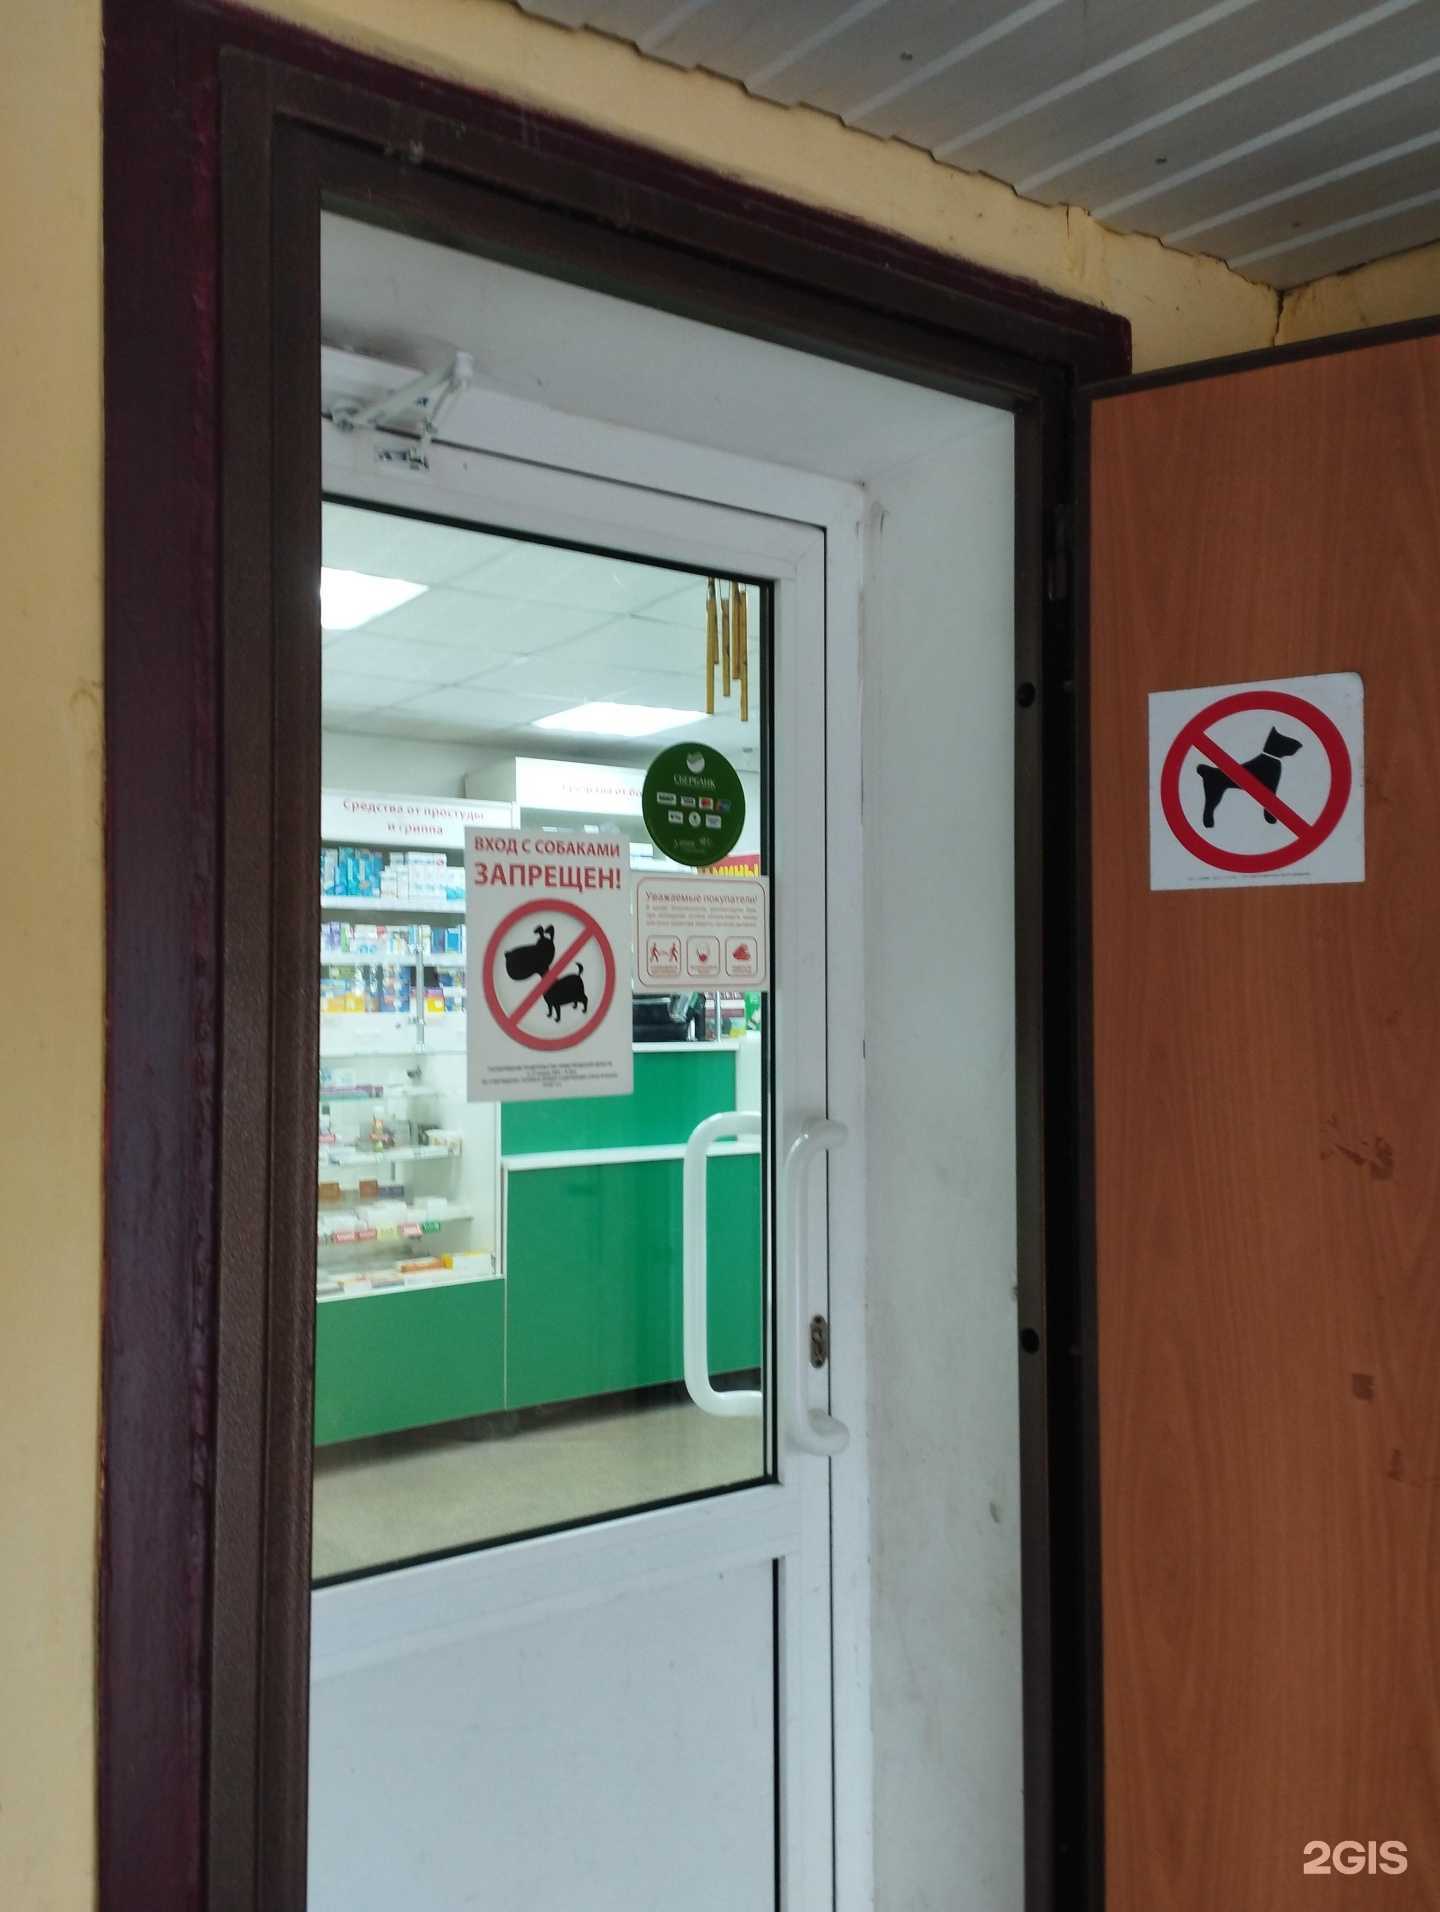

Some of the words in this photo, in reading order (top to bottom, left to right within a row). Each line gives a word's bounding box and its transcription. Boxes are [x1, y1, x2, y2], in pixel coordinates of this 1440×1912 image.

[343, 798, 403, 814] Средства
[407, 806, 421, 815] от
[424, 807, 484, 821] простуды
[474, 836, 518, 855] ВХОД
[521, 838, 531, 854] С
[535, 838, 620, 857] СОБАКАМИ
[474, 862, 621, 892] ЗАПРЕЩЕН!
[646, 891, 701, 903] Уважаемые
